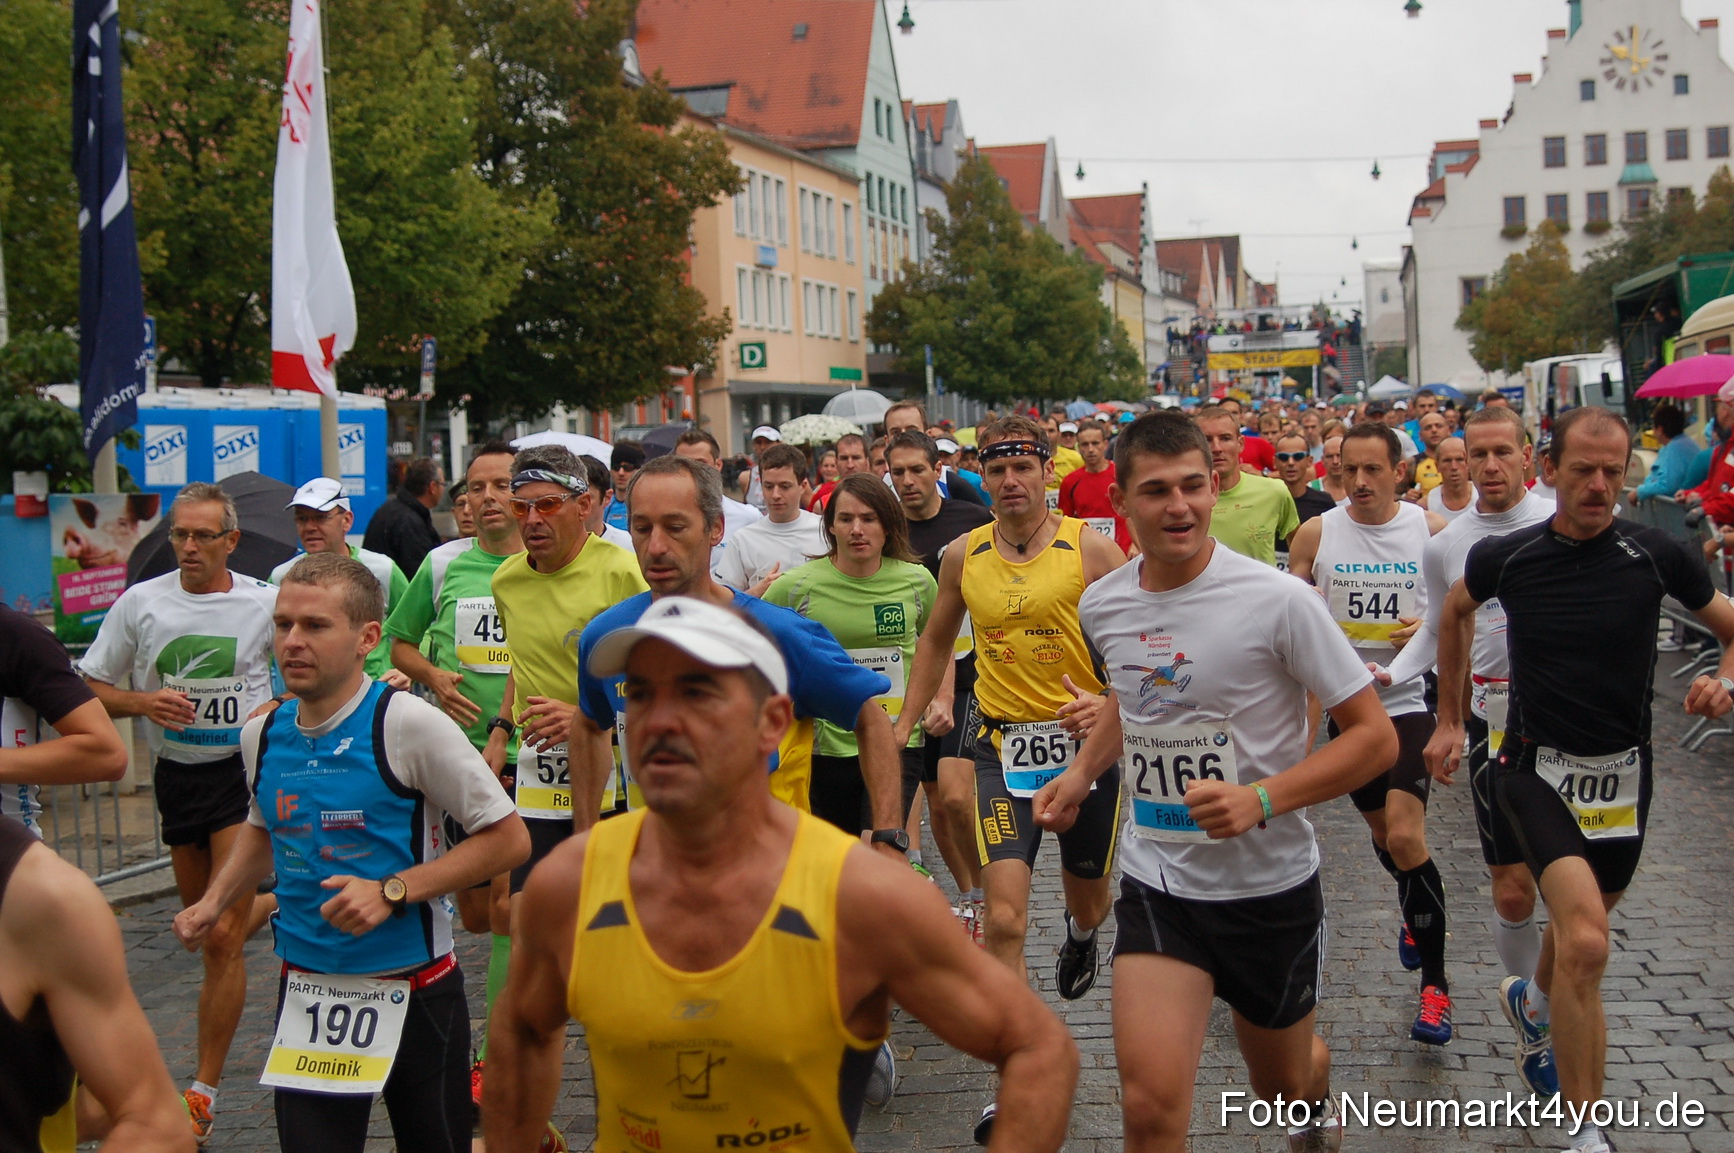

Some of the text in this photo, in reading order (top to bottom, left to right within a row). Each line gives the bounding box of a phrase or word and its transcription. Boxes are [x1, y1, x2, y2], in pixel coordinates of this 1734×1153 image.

[742, 345, 763, 366] D
[145, 431, 186, 462] DIXI
[214, 431, 258, 461] DIXI
[338, 429, 363, 449] IXI
[1334, 562, 1418, 575] SIEMENS
[1332, 579, 1402, 589] PARTL Neumarkt
[1348, 592, 1400, 620] 544
[878, 623, 904, 634] Bank
[985, 630, 1004, 641] Seidl
[488, 650, 510, 662] Udo
[1031, 644, 1064, 655] PIZZERIA
[1037, 651, 1062, 661] ELIO
[852, 655, 888, 665] eumarkt
[190, 686, 231, 694] Neumarkt
[186, 695, 239, 725] 740
[1007, 722, 1061, 733] ARTL Neum
[178, 730, 229, 744] Siegfried
[1124, 733, 1208, 749] PARTL Neumarkt
[1538, 754, 1574, 768] PARTL
[1035, 773, 1062, 787] Pet
[1132, 752, 1225, 798] 2166
[1558, 772, 1620, 804] 400
[553, 793, 573, 806] Ra
[996, 802, 1015, 836] Run!
[1155, 808, 1195, 828] Fabia
[1578, 812, 1605, 826] rank
[987, 818, 999, 842] Team
[288, 981, 386, 1002] PARTL Neumarkt
[305, 1001, 379, 1049] 190
[295, 1055, 363, 1077] Dominik
[619, 1116, 662, 1150] Seidl
[716, 1117, 811, 1148] RÖDL
